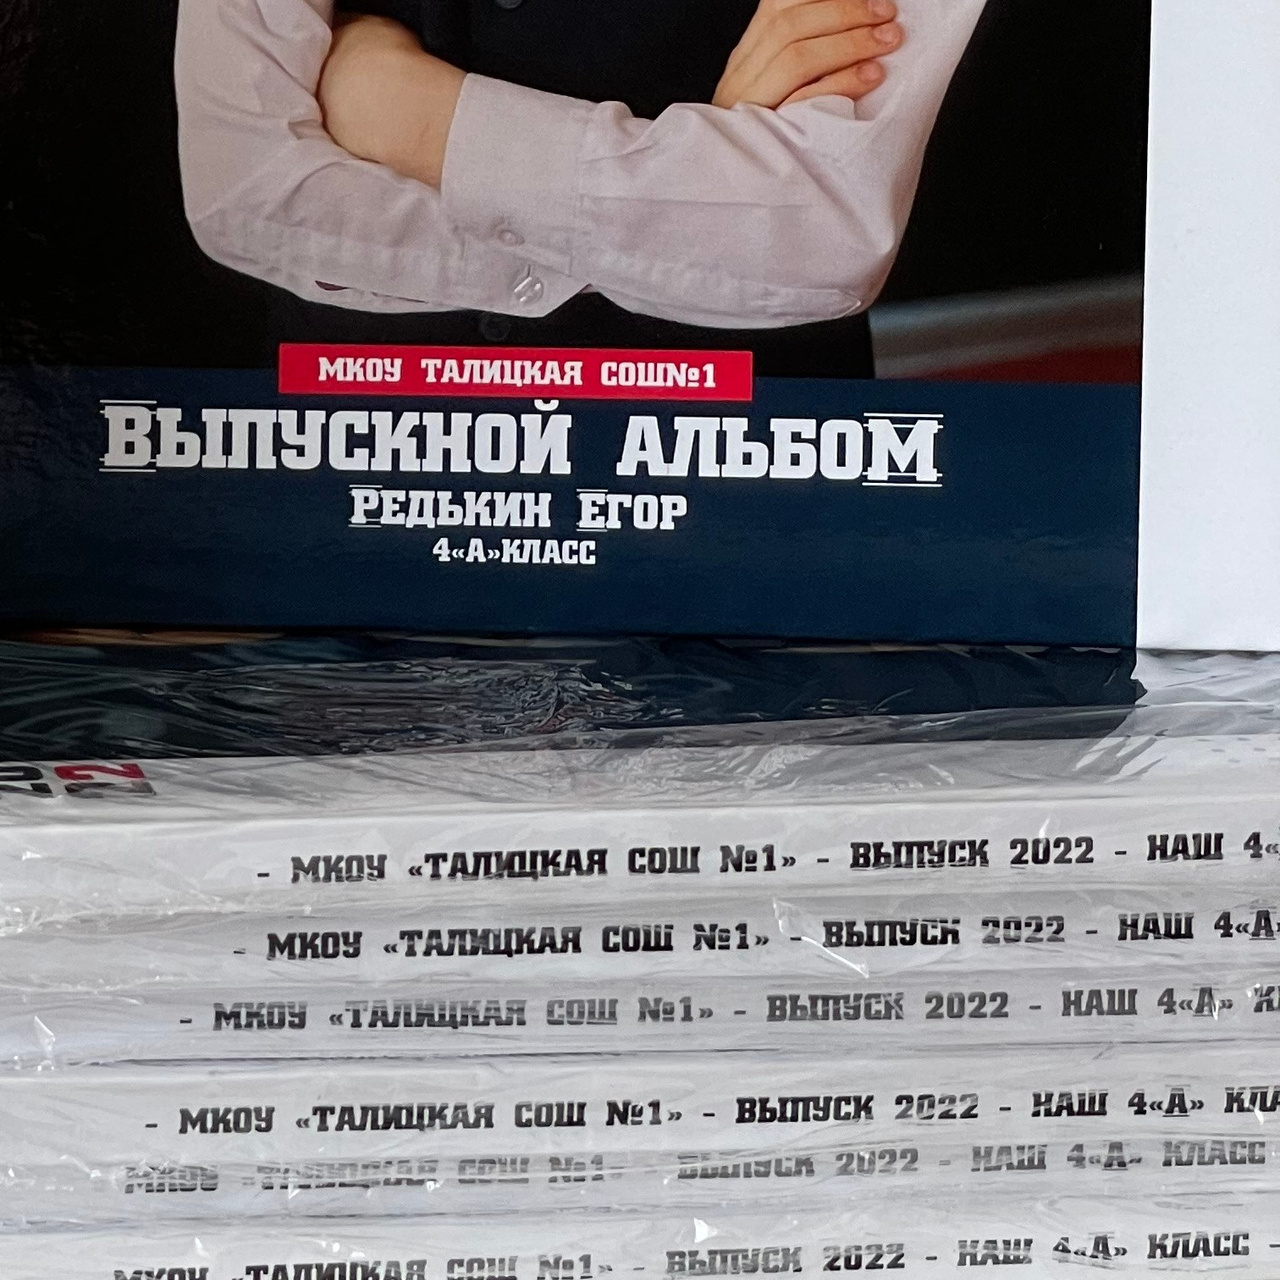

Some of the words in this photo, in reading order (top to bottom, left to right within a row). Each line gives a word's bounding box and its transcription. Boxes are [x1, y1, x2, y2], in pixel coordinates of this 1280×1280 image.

[318, 357, 402, 383] МКОУ
[421, 358, 583, 388] ТАЛИЦКАЯ
[601, 361, 716, 389] СОШ№1
[99, 399, 572, 475] ВЫПУСКНОЙ
[616, 413, 943, 487] АЛЬБОМ
[349, 484, 552, 529] РЕДЬКИН
[576, 489, 687, 532] ЕГОР
[433, 537, 596, 565] 4«А»КЛАСС
[291, 854, 388, 884] МКОУ
[408, 847, 608, 881] «ТАЛИЦКАЯ
[628, 845, 700, 874] СОШ
[720, 843, 797, 873] №1»
[850, 839, 990, 870] ВЫПУСК
[1009, 836, 1095, 866] 2022
[1146, 832, 1224, 862] НАШ
[267, 932, 363, 960] МКОУ
[383, 927, 581, 958] «ТАЛИЦКАЯ
[602, 923, 674, 952] СОШ
[692, 922, 770, 951] №1»
[822, 918, 960, 949] ВЫПУСК
[981, 916, 1066, 944] 2022
[1117, 912, 1194, 940] НАШ
[1214, 909, 1280, 940] 4«А
[213, 1002, 307, 1030] МКОУ
[546, 997, 618, 1025] СОШ
[637, 996, 713, 1023] №1»
[766, 991, 905, 1021] ВЫПУСК
[924, 992, 1010, 1020] 2022
[1061, 988, 1138, 1017] НАШ
[178, 1106, 275, 1134] МКОУ
[295, 1103, 494, 1132] «ТАЛИЦКАЯ
[514, 1102, 586, 1128] СОШ
[606, 1100, 683, 1126] №1»
[736, 1096, 874, 1124] ВЫПУСК
[894, 1092, 979, 1121] 2022
[1031, 1091, 1108, 1118] НАШ
[1127, 1086, 1204, 1118] 4«А»
[835, 1149, 919, 1175] 2022
[971, 1144, 1046, 1171] НАШ
[1161, 1141, 1266, 1166] КЛАСС
[822, 1242, 905, 1271] 2022
[1147, 1232, 1249, 1260] КЛАСС
